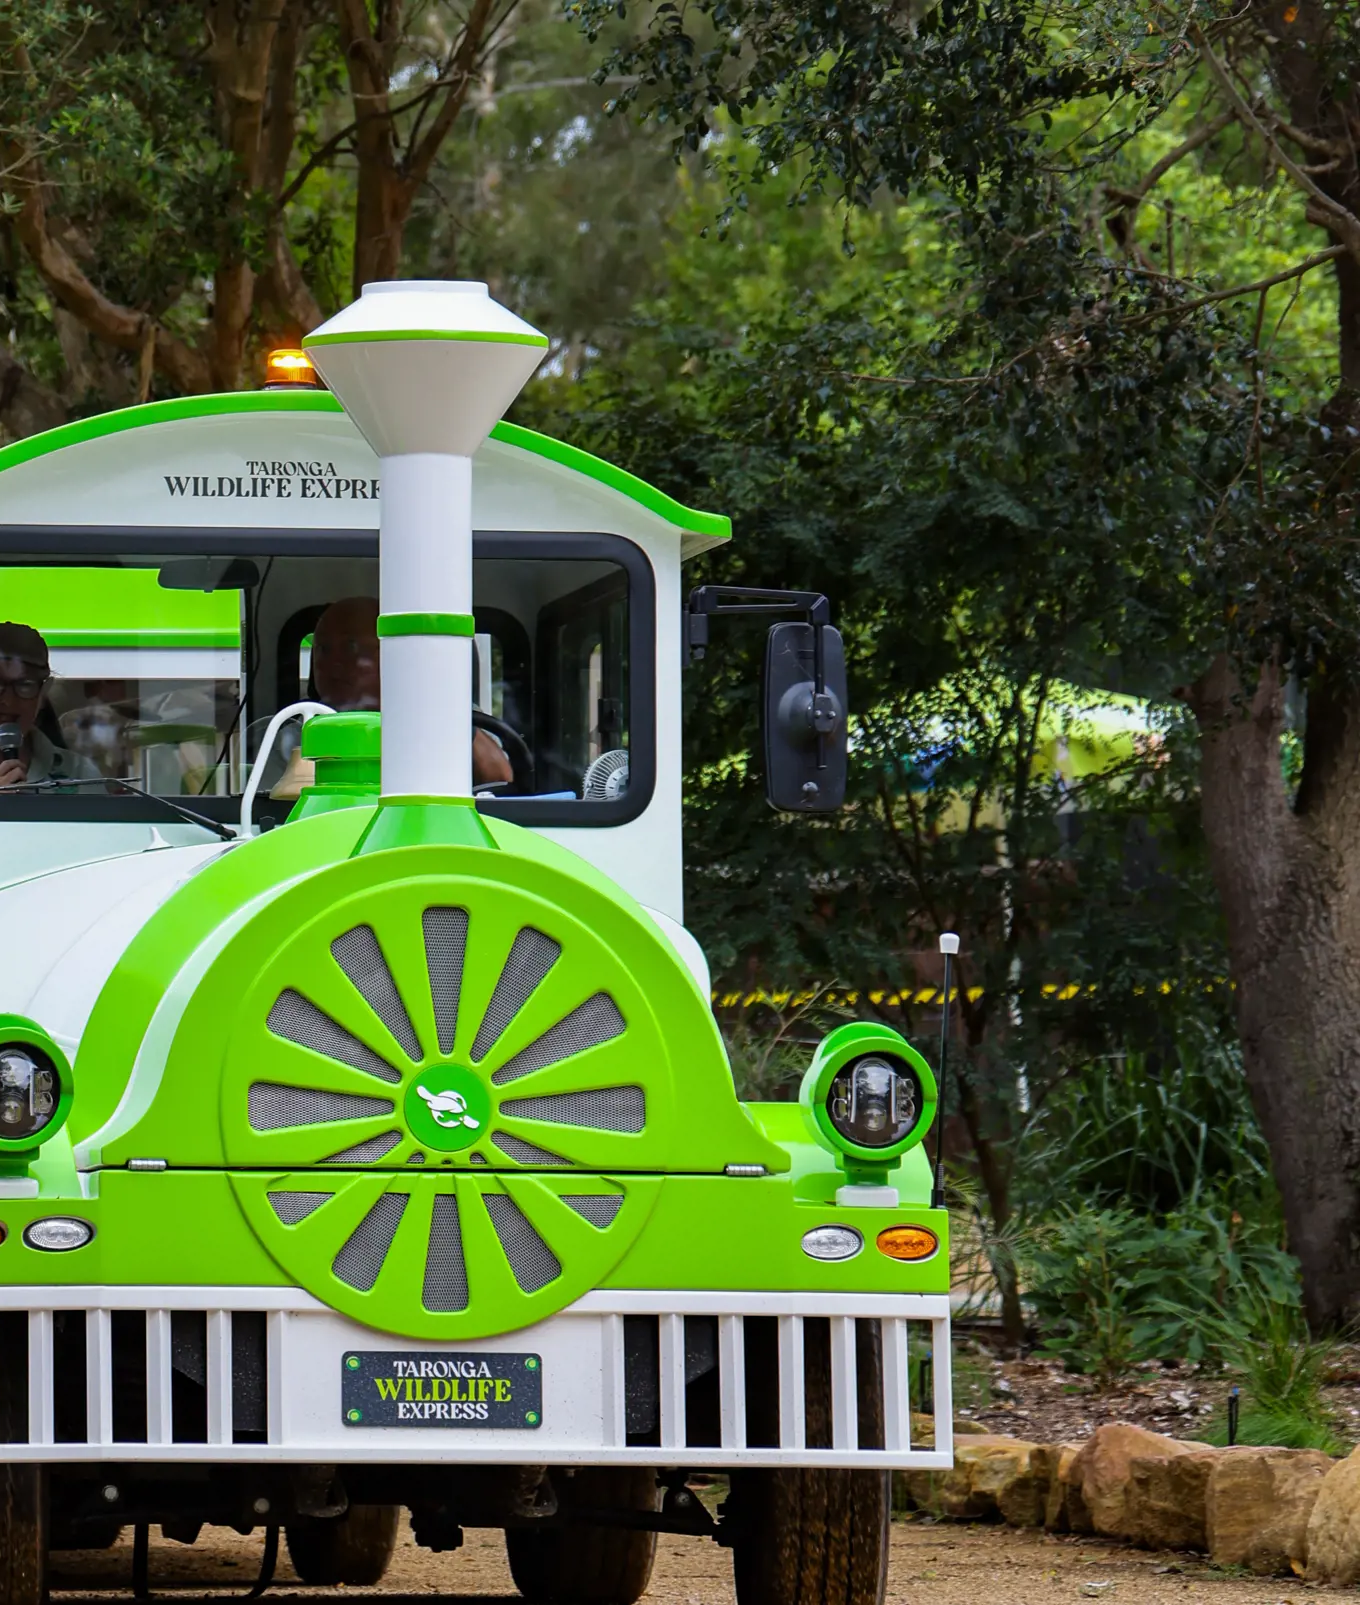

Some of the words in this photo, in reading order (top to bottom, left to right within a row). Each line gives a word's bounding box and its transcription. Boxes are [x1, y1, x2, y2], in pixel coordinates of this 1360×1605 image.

[246, 461, 338, 477] TARONGA
[164, 475, 292, 498] WILDLIFE
[393, 1360, 492, 1378] TARONGA
[374, 1378, 512, 1402] WILDLIFE
[397, 1402, 489, 1419] EXPRESS
